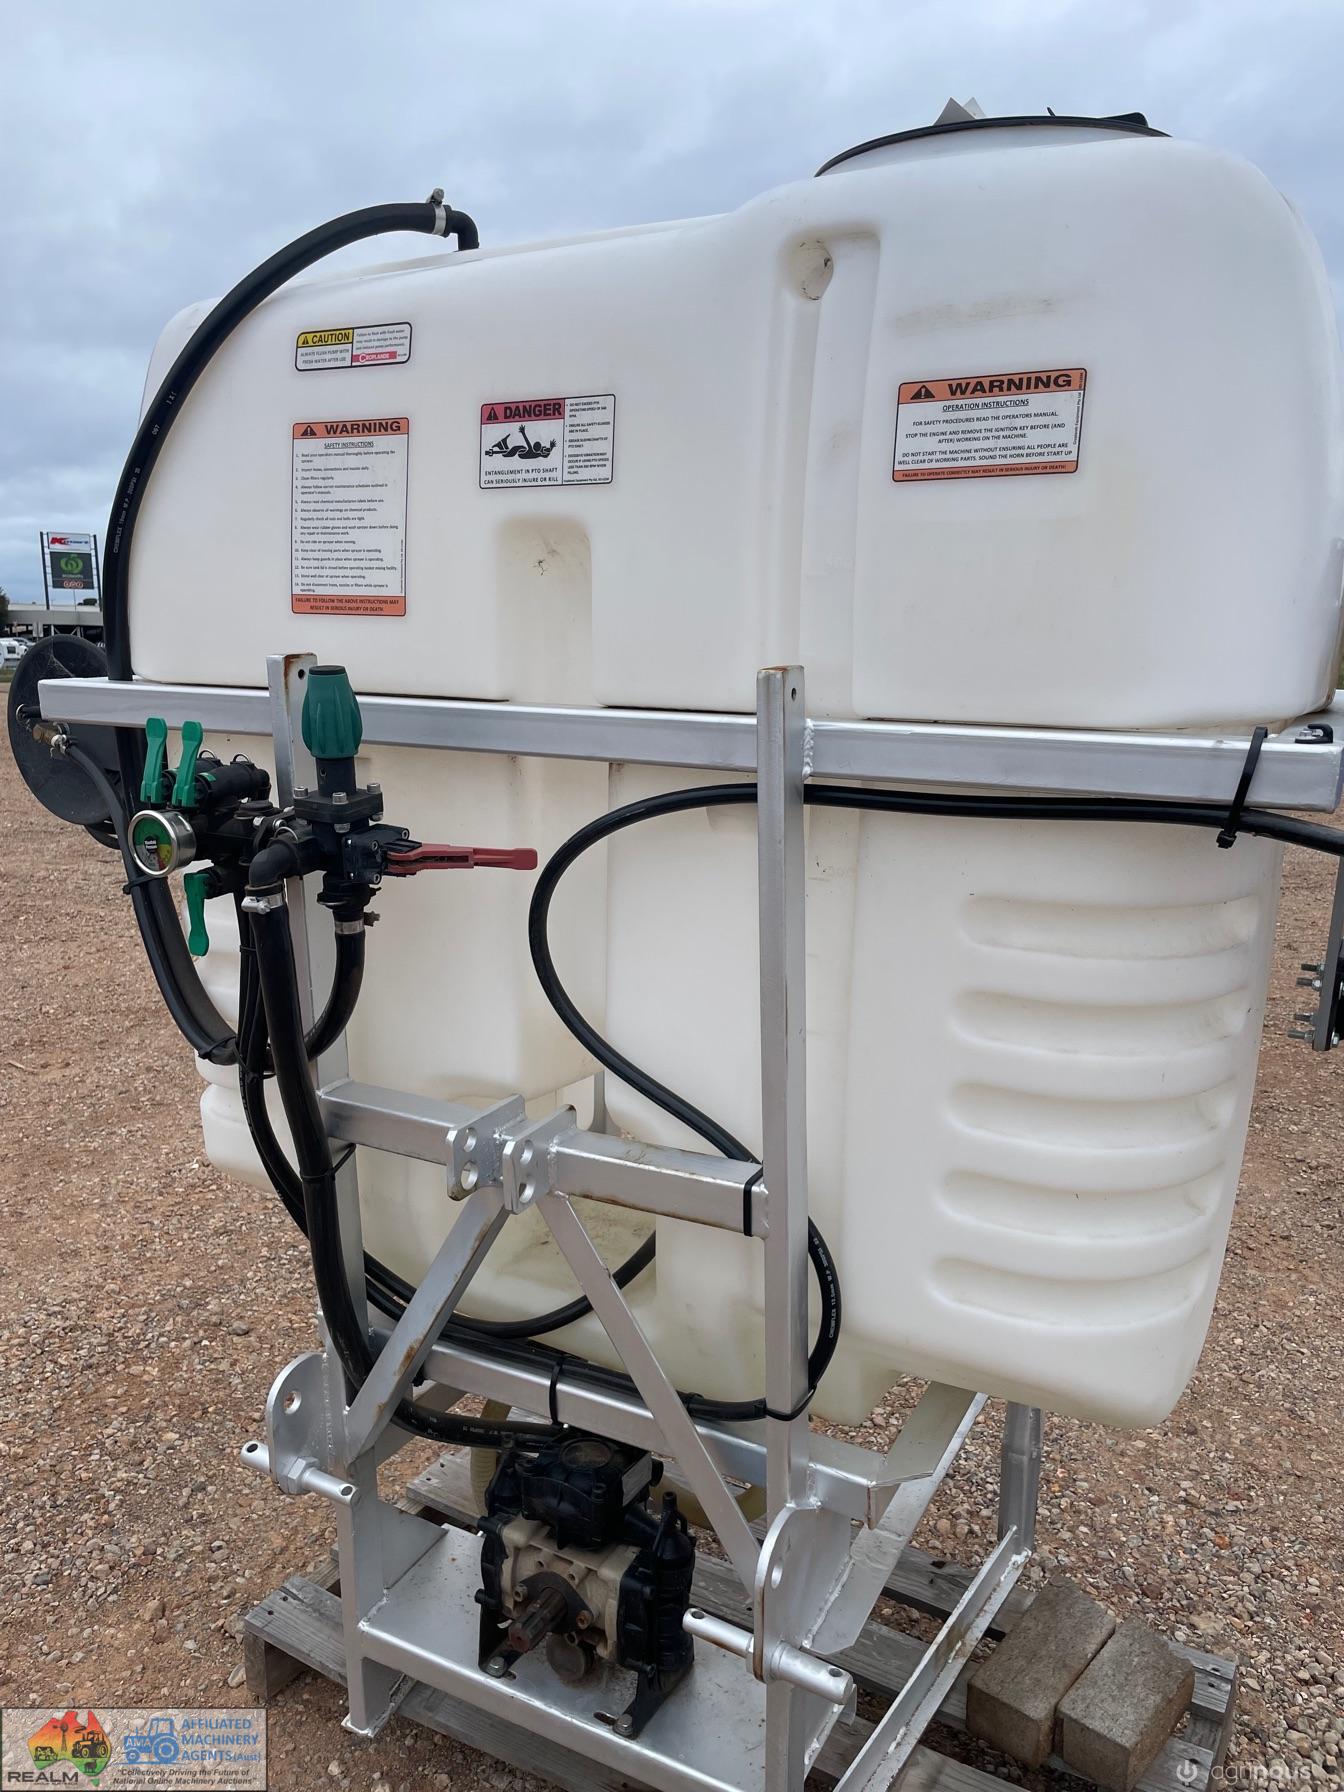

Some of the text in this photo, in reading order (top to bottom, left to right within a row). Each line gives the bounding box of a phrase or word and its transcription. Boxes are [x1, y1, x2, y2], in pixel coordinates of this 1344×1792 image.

[312, 332, 350, 344] CAUTION
[947, 373, 1073, 397] WARNING
[504, 402, 562, 420] DANGER
[942, 398, 1030, 412] OPERATION INSTRUCTIONS
[942, 417, 975, 425] PROCEDURES
[1001, 413, 1033, 421] OPERATORS
[325, 421, 401, 435] WARNING
[929, 430, 948, 438] ENGINE
[961, 428, 983, 436] REMOVE
[994, 426, 1018, 434] IGNITION
